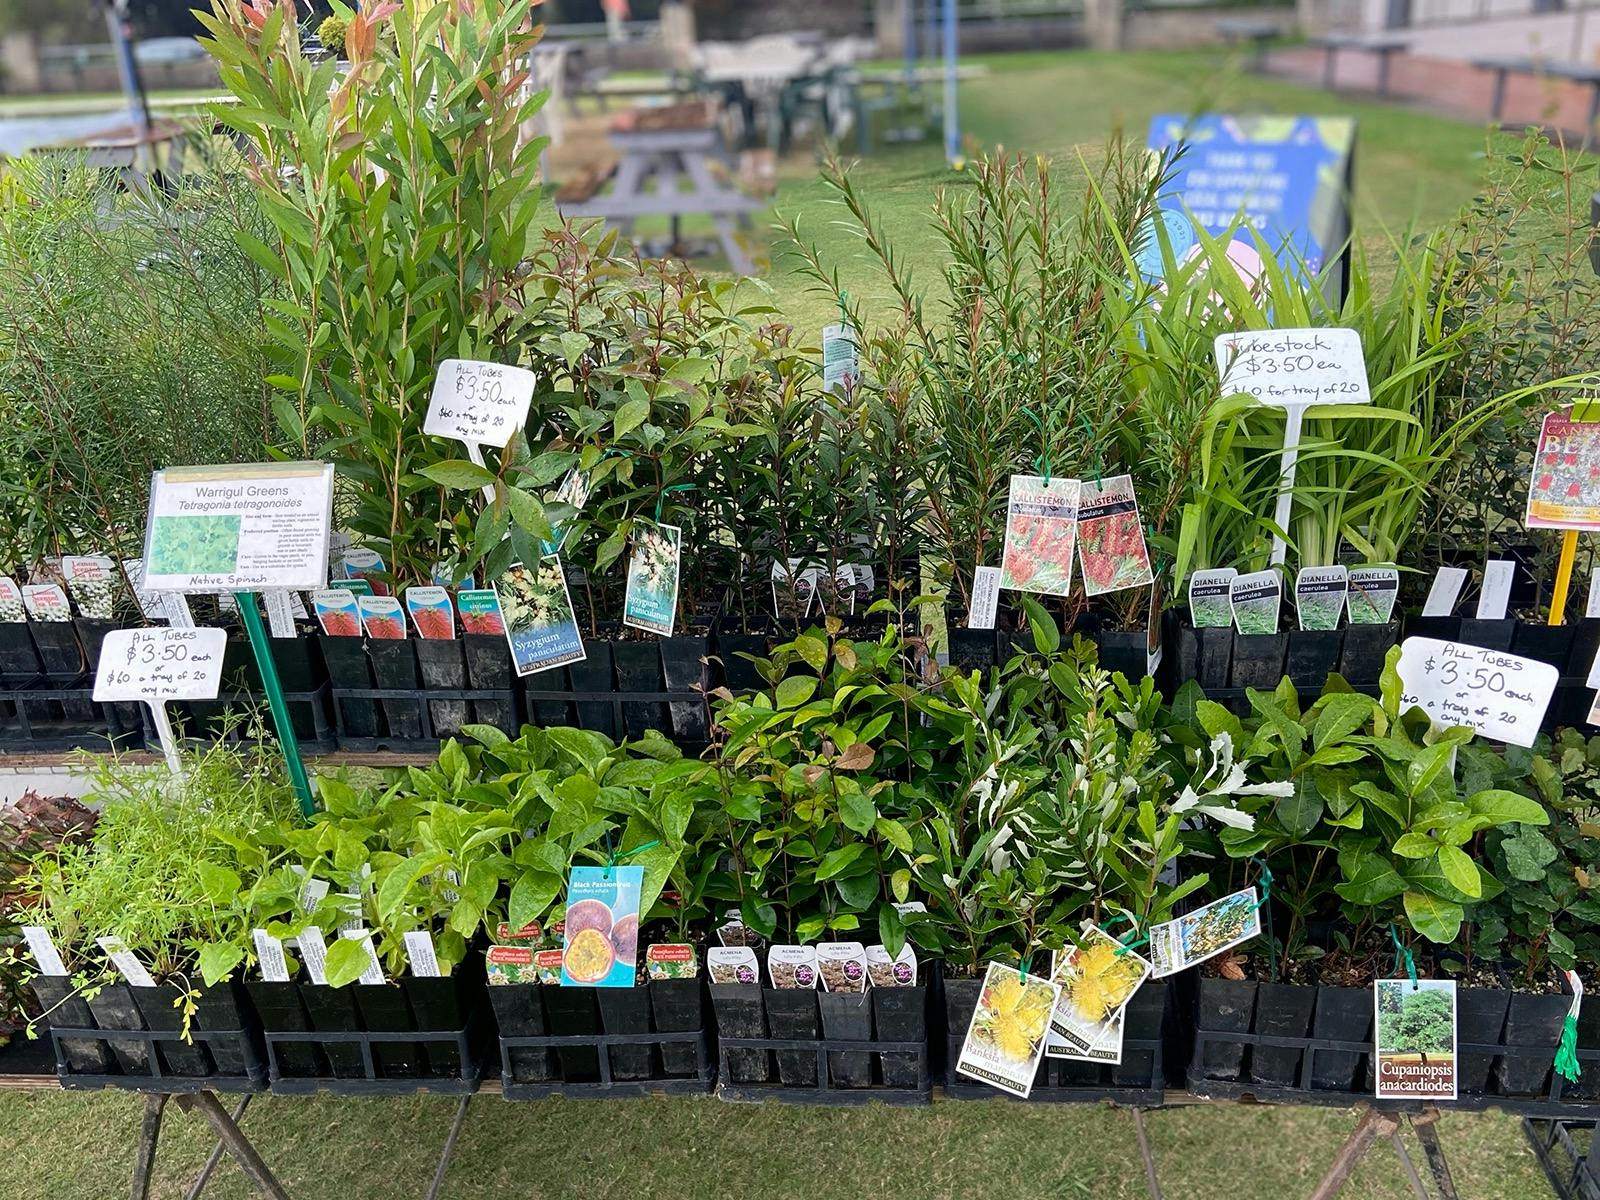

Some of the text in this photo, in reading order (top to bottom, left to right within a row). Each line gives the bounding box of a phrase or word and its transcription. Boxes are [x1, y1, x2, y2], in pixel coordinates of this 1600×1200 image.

[456, 363, 503, 378] ALL TUBES
[1246, 355, 1314, 375] $3.50
[456, 375, 502, 403] $3.50
[1267, 384, 1290, 396] for
[1291, 383, 1319, 400] tray
[1324, 382, 1337, 394] of
[1340, 382, 1360, 393] 20
[439, 405, 453, 418] $60
[462, 412, 478, 425] tray
[492, 417, 505, 427] 20
[196, 486, 289, 499] Warrigul Greens
[179, 498, 302, 512] Tetragonia tetragonoides
[1013, 495, 1073, 506] CALLISTEMON
[190, 575, 267, 586] Native Spinach
[1301, 574, 1343, 583] DIANELLA
[1351, 572, 1393, 581] DIANELLA
[1193, 588, 1221, 596] caerulea
[1233, 579, 1274, 592] DIANELLA
[1300, 584, 1329, 592] caerulea
[1234, 591, 1262, 601] caerulea
[132, 629, 197, 644] ALL TUBES
[514, 633, 560, 652] Syzygium
[127, 644, 212, 665] $3.50 each
[527, 640, 578, 661] paniculatum
[1442, 643, 1523, 671] ALL TUBES
[107, 670, 130, 686] $60
[150, 673, 173, 683] tray
[177, 671, 188, 680] of
[193, 671, 206, 680] 20
[1425, 656, 1534, 702] $3.50 each
[141, 687, 157, 696] any
[1442, 700, 1468, 716] tray
[1474, 707, 1489, 716] of
[1499, 712, 1517, 724] 20
[1441, 714, 1460, 726] any
[1065, 1031, 1088, 1051] BEAUTY
[965, 1043, 1000, 1063] Banksia
[1090, 1051, 1115, 1059] BEAUTY
[961, 1063, 1025, 1091] AUSTRALIAN BEAUTY
[1381, 1061, 1453, 1080] Cupaniopsis
[1380, 1079, 1454, 1092] anacardiodes
